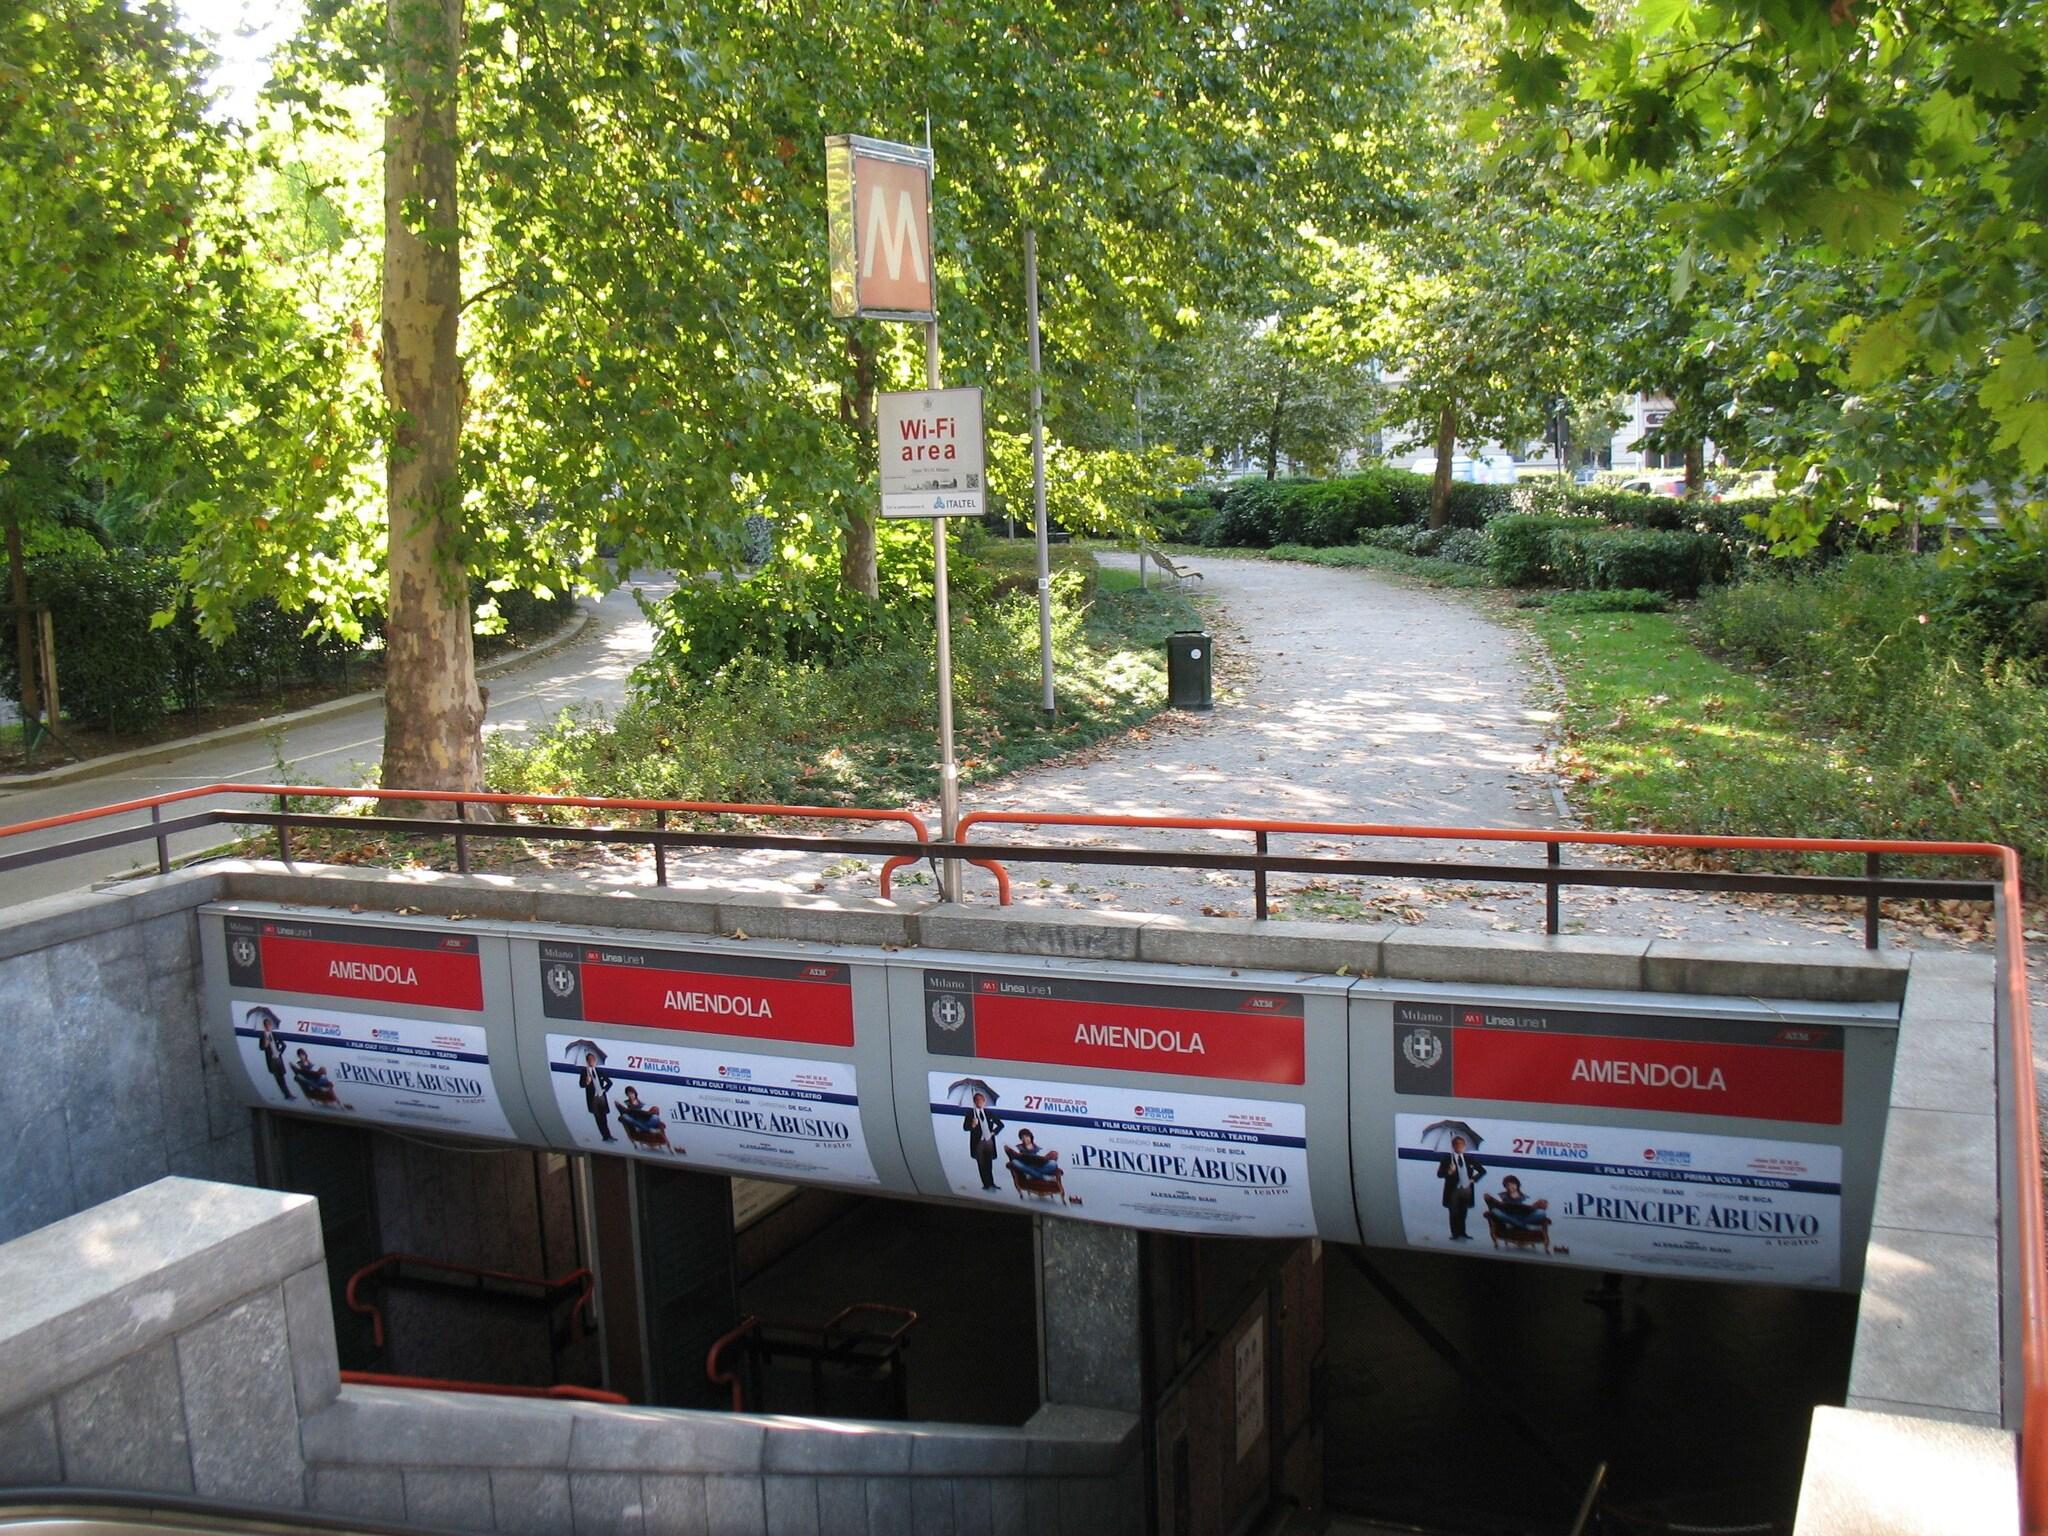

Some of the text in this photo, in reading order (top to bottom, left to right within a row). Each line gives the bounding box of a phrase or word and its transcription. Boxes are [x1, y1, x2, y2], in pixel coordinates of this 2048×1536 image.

[862, 185, 927, 283] M
[900, 417, 955, 440] Wi-Fi
[902, 443, 956, 462] area
[946, 499, 976, 509] ITALTEL
[544, 948, 574, 959] Milano
[601, 953, 623, 963] Linea
[623, 954, 639, 964] Line
[640, 956, 644, 964] 1
[328, 960, 418, 986] AMENDOLA
[930, 977, 965, 989] Milano
[982, 982, 1052, 996] M1 Linea Line 1
[664, 990, 772, 1018] AMENDOLA
[1252, 1000, 1273, 1008] ATM
[1402, 1010, 1443, 1022] Milano
[1464, 1013, 1547, 1028] M1 Linea Line 1
[296, 1020, 310, 1032] 27
[1074, 1022, 1206, 1054] AMENDOLA
[627, 1056, 644, 1069] 27
[644, 1063, 680, 1074] MILANO
[340, 1062, 416, 1088] PRINCIPE
[416, 1073, 482, 1096] ABUSIVO
[1570, 1058, 1727, 1092] AMENDOLA
[692, 1080, 708, 1088] FILM
[708, 1081, 725, 1089] CULT
[748, 1086, 768, 1094] PRIMA
[770, 1088, 790, 1096] VOLTA
[796, 1090, 822, 1100] TEATRO
[1024, 1096, 1042, 1110] 27
[1044, 1102, 1088, 1114] MILANO
[670, 1100, 850, 1140] il PRINCIPE ABUSIVO
[1102, 1121, 1120, 1130] FILM
[1122, 1122, 1141, 1131] CULT
[1142, 1124, 1158, 1132] PER
[1158, 1126, 1168, 1134] LA
[1169, 1127, 1194, 1136] PRIMA
[1196, 1130, 1220, 1139] VOLTA
[1227, 1133, 1258, 1142] TEATRO
[822, 1141, 852, 1149] teatro
[1216, 1146, 1228, 1154] DE
[1228, 1148, 1246, 1156] SICA
[1512, 1138, 1534, 1154] 27
[1536, 1146, 1588, 1160] MILANO
[1071, 1144, 1288, 1186] il PRINCIPE ABUSIVO
[1604, 1166, 1626, 1176] FILM
[1627, 1168, 1650, 1178] CULT
[1651, 1170, 1669, 1179] PER
[1670, 1172, 1682, 1180] LA
[1683, 1172, 1713, 1183] PRIMA
[1714, 1175, 1743, 1186] VOLTA
[1753, 1178, 1790, 1189] TEATRO
[1254, 1188, 1289, 1196] teatro
[1738, 1194, 1752, 1202] DE
[1563, 1192, 1820, 1237] il PRINCIPE ABUSIVO
[1777, 1238, 1818, 1246] teatro
